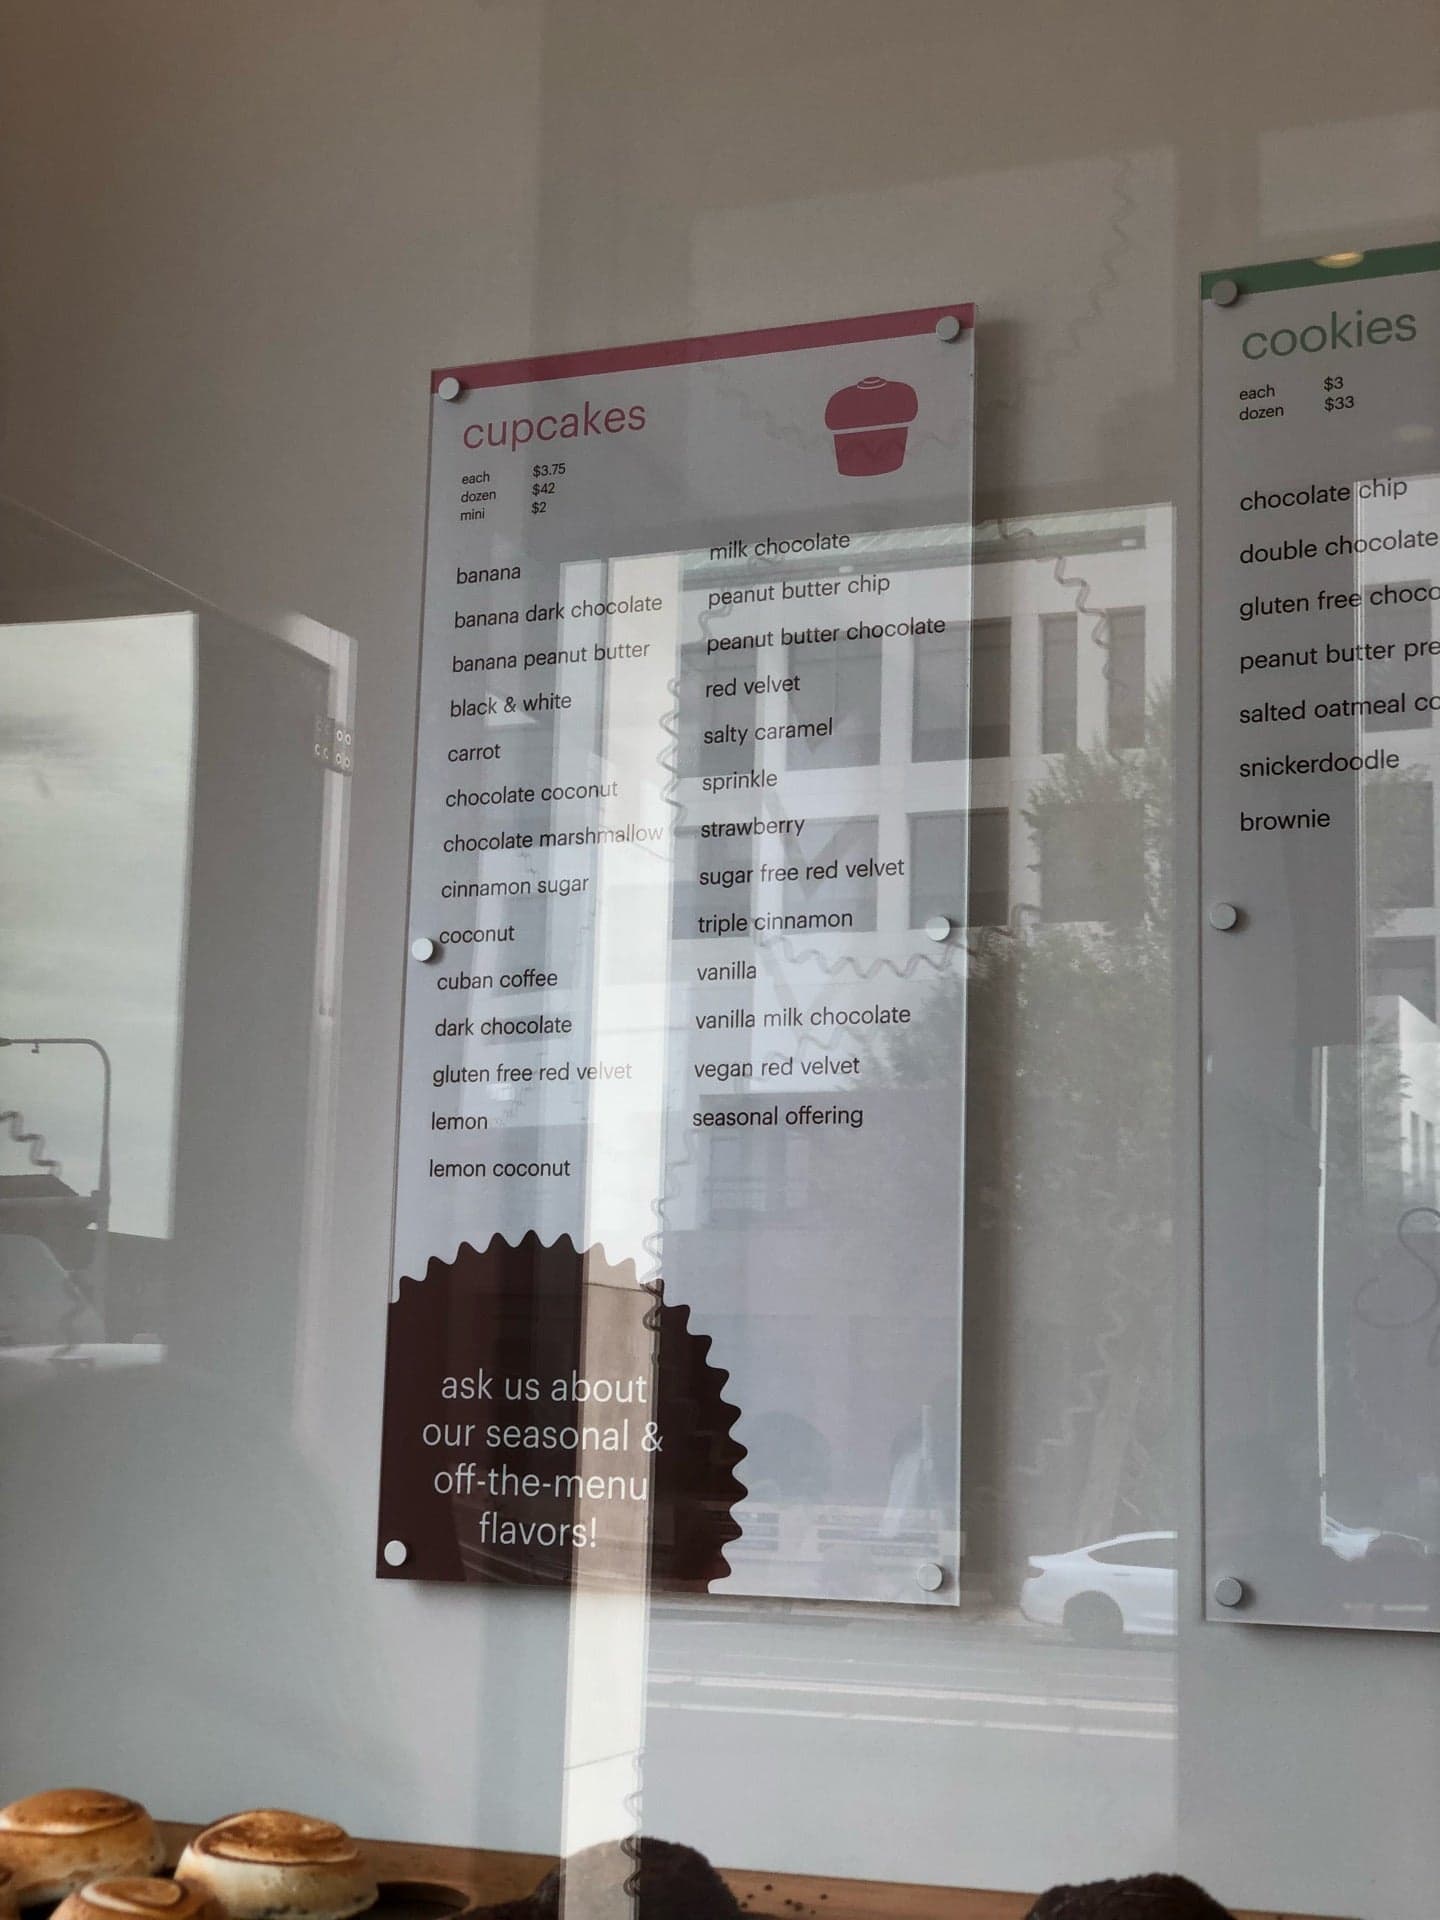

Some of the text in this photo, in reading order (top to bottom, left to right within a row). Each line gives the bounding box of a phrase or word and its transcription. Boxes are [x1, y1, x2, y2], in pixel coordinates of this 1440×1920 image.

[1243, 309, 1416, 360] cookies
[1240, 376, 1343, 400] each $3
[1239, 396, 1354, 421] dozen $33
[464, 401, 645, 452] cupcakes
[462, 463, 565, 484] each $3.75
[461, 482, 555, 503] dozen $42
[1240, 477, 1408, 511] chocolate chip
[461, 502, 546, 521] mini $2
[711, 533, 850, 560] milk chocolate
[1240, 529, 1438, 563] double chocolate
[457, 567, 520, 584] banana
[709, 575, 890, 609] peanut butter chip
[455, 596, 662, 628] banana dark chocolate
[1240, 596, 1308, 621] gluten
[1317, 590, 1362, 610] free
[707, 617, 945, 655] peanut butter chocolate
[453, 641, 650, 672] banana peanut butter
[1241, 648, 1317, 674] peanut
[1327, 641, 1395, 663] butter
[706, 675, 800, 697] red velvet
[451, 693, 571, 717] black & white
[1240, 700, 1305, 723] salted
[1314, 693, 1405, 718] oatmeal
[704, 717, 832, 746] salty caramel
[448, 744, 501, 762] carrot
[1240, 749, 1399, 777] snickerdoodle
[703, 769, 777, 794] sprinkle
[446, 782, 617, 807] chocolate coconut
[701, 817, 805, 838] strawberry
[1241, 809, 1330, 831] brownie
[444, 824, 663, 852] chocolate marshmallow
[700, 858, 904, 888] sugar free red velvet
[442, 878, 589, 898] cinnamon sugar
[440, 926, 515, 944] coconut
[698, 912, 852, 936] triple cinnamon
[437, 969, 557, 990] cuban coffee
[697, 961, 756, 980] vanilla
[435, 1015, 572, 1036] dark chocolate
[696, 1005, 910, 1029] vanilla milk chocolate
[433, 1062, 631, 1087] gluten free red velvet
[695, 1056, 860, 1081] vegan red velvet
[432, 1112, 487, 1130] lemon
[693, 1105, 863, 1128] seasonal offering
[430, 1159, 570, 1177] lemon coconut
[442, 1368, 646, 1403] ask us about
[423, 1419, 663, 1452] our seasonal &
[435, 1463, 646, 1500] off-the-menu
[479, 1511, 595, 1547] flavors!
